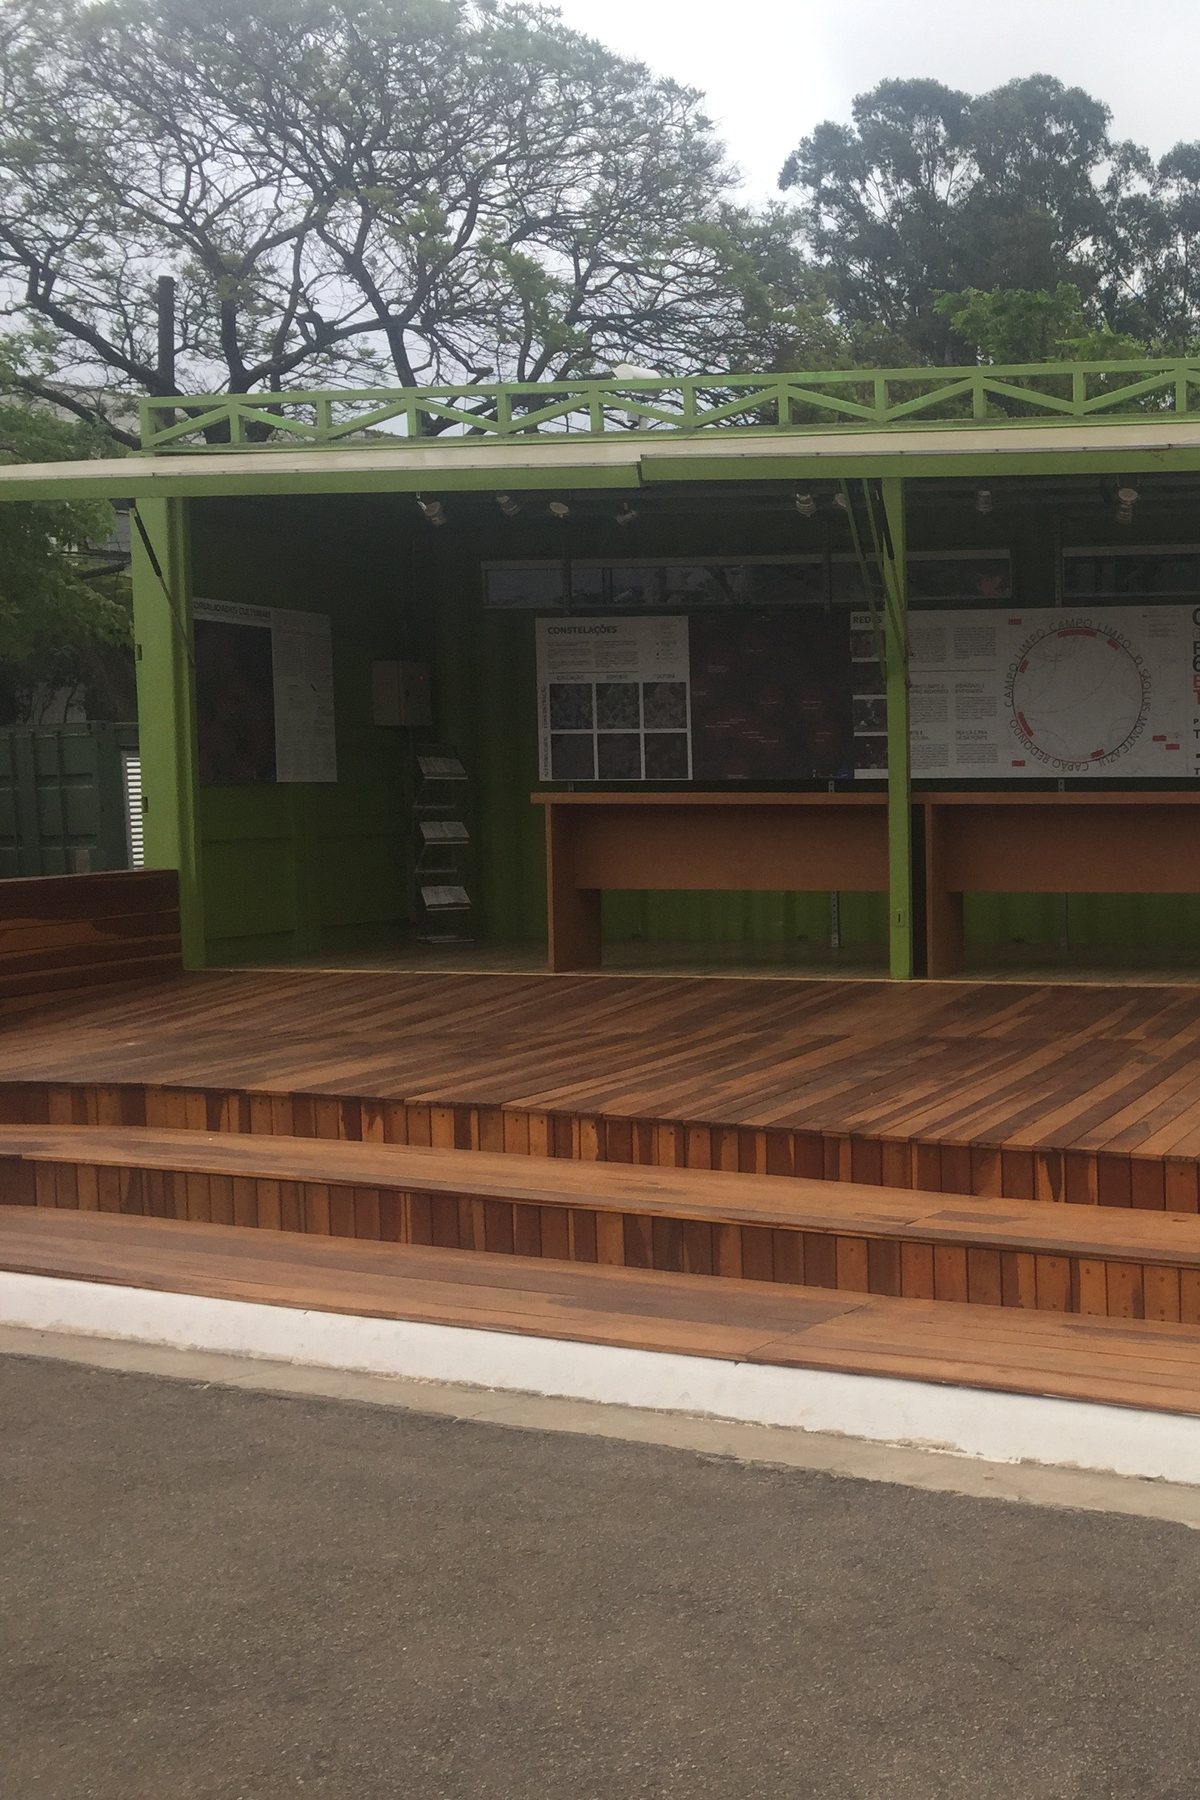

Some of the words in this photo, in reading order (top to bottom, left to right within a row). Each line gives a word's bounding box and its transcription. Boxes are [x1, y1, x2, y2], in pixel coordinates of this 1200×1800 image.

[547, 624, 617, 636] CONSTELAÇÕES
[852, 615, 882, 624] REDS
[1049, 617, 1093, 631] CAMPO
[1097, 624, 1132, 649] LIMPO
[1004, 663, 1018, 707] CAMPO
[1014, 628, 1045, 659] LIMPO
[1009, 719, 1050, 766] REDONDO
